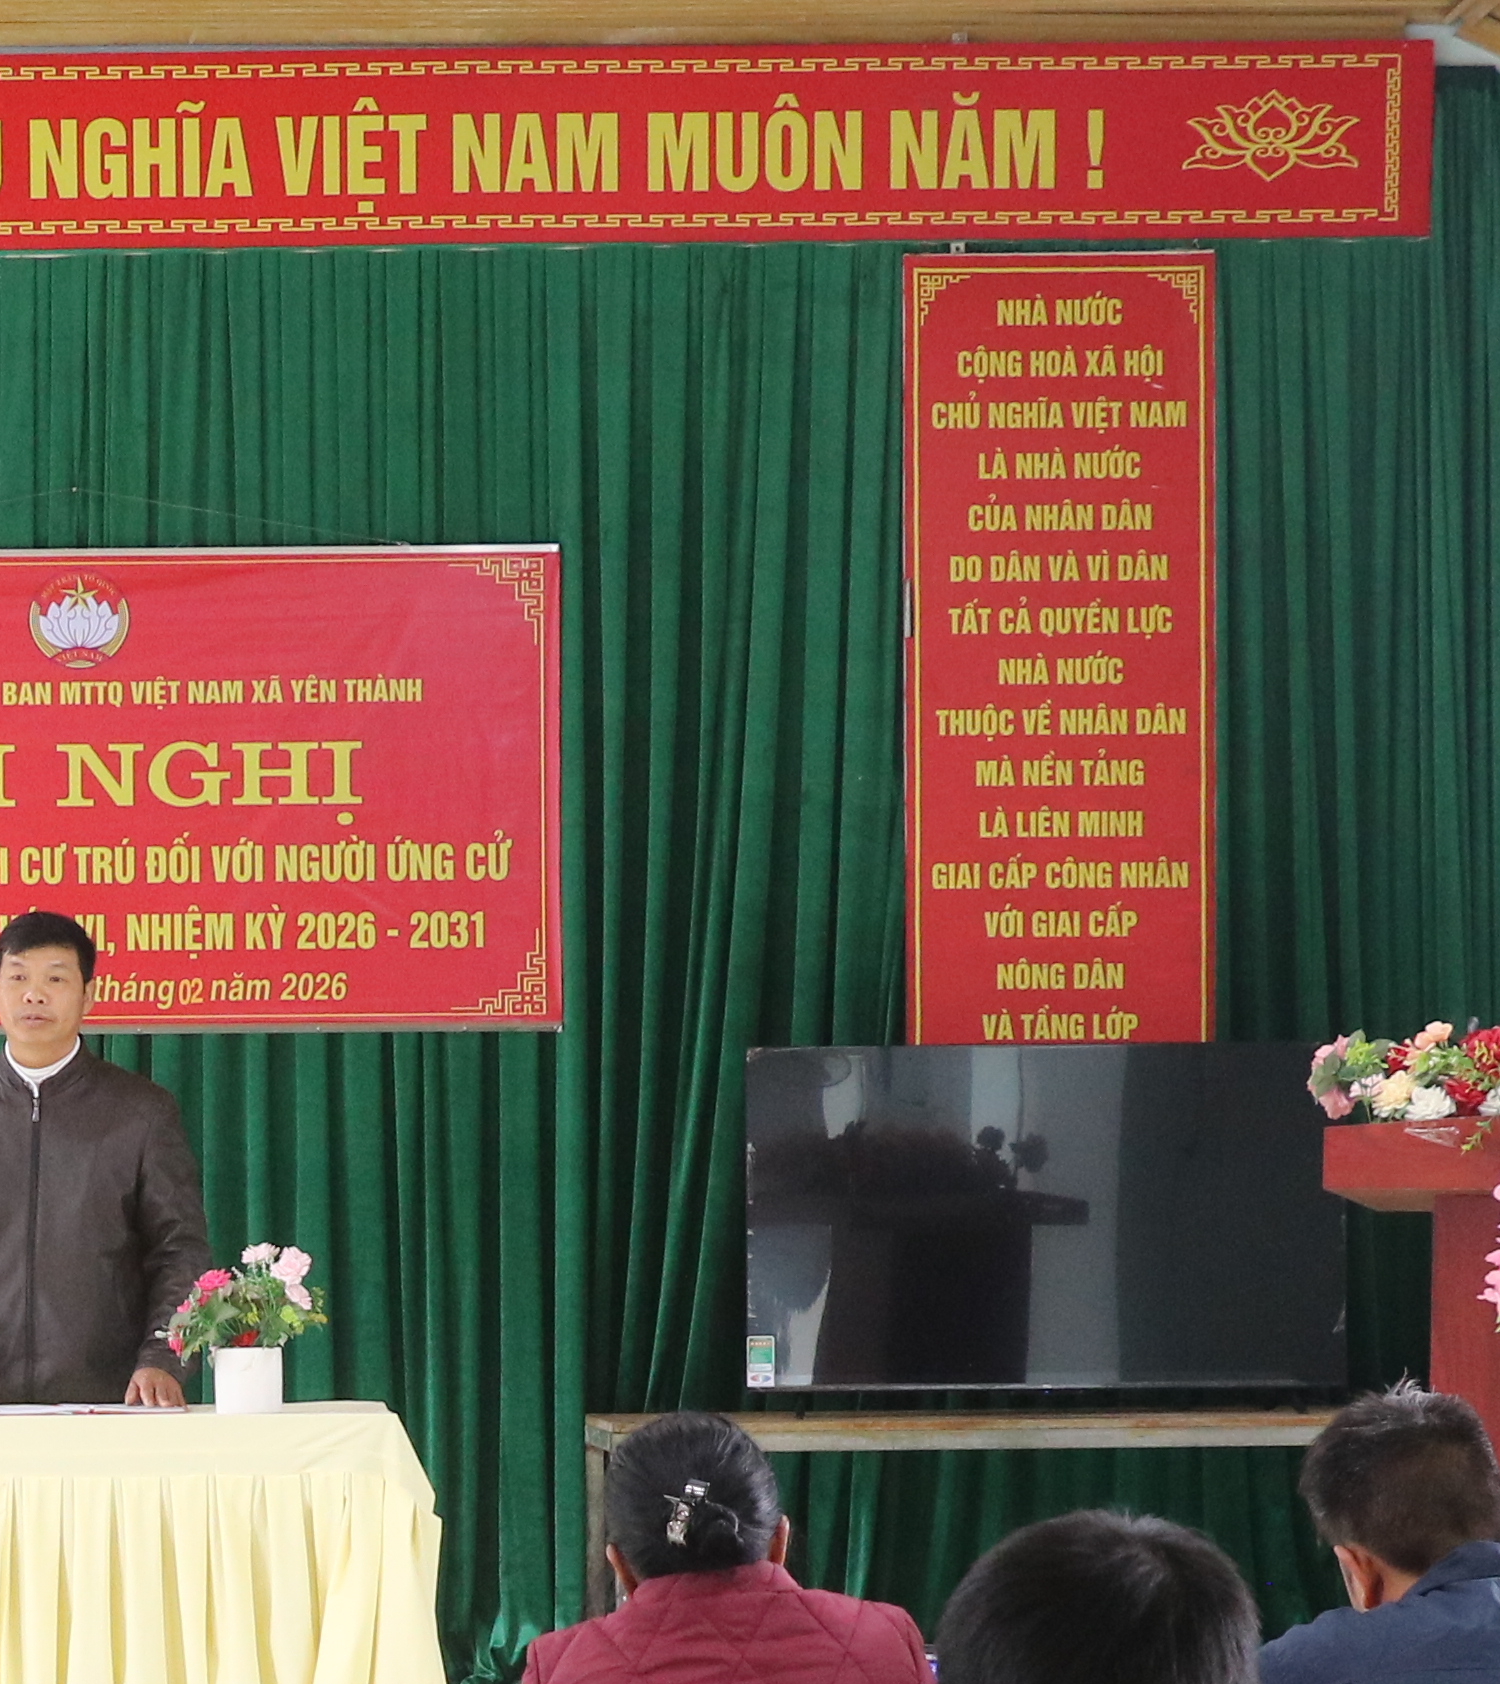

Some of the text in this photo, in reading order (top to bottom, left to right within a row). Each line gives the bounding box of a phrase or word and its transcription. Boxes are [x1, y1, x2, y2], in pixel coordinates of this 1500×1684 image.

[29, 101, 252, 199] NGHĨA
[275, 97, 427, 213] VIỆT
[453, 113, 618, 193] NAM
[647, 93, 862, 192] MUÔN
[890, 92, 1055, 189] NĂM
[1087, 109, 1104, 189] !
[997, 291, 1122, 326] NHÀ NƯỚC
[958, 344, 1163, 383] CỘNG HOÀ XÃ HỘI
[932, 391, 1186, 434] CHỦ NGHĨA VIỆT NAM
[979, 444, 1140, 479] LÀ NHÀ NƯỚC
[968, 494, 1152, 531] CỦA NHÂN DÂN
[948, 596, 1172, 639] TẤT CẢ QUYỀN LỰC
[3, 682, 51, 705] BAN
[60, 681, 123, 707] MTTQ
[131, 676, 180, 709] VIỆT
[188, 680, 243, 704] NAM
[252, 675, 283, 703] XÃ
[291, 674, 336, 703] YÊN
[343, 674, 422, 702] THÀNH
[935, 699, 1186, 742] THUỘC VỀ NHÂN DÂN
[56, 741, 362, 825] NGHỊ
[20, 843, 67, 885] CƯ
[73, 838, 135, 884] TRÚ
[145, 832, 200, 883] ĐỐI
[211, 837, 263, 883] VỚI
[275, 835, 375, 882] NGƯỜI
[387, 835, 454, 881] ỨNG
[466, 830, 512, 881] CỬ
[932, 853, 1188, 889] GIAI CẤP CÔNG NHÂN
[127, 905, 233, 959] NHIỆM
[245, 904, 286, 950] KỲ
[297, 912, 376, 949] 2026
[387, 929, 399, 937] -
[410, 911, 484, 948] 2031
[984, 901, 1137, 938] VỚI GIAI CẤP
[93, 973, 175, 1009] tháng
[179, 978, 203, 1005] 02
[210, 972, 270, 1001] năm
[280, 972, 347, 1001] 2026
[997, 958, 1124, 990] NÔNG DÂN
[982, 1004, 1138, 1040] VÀ TẦNG LỚP
